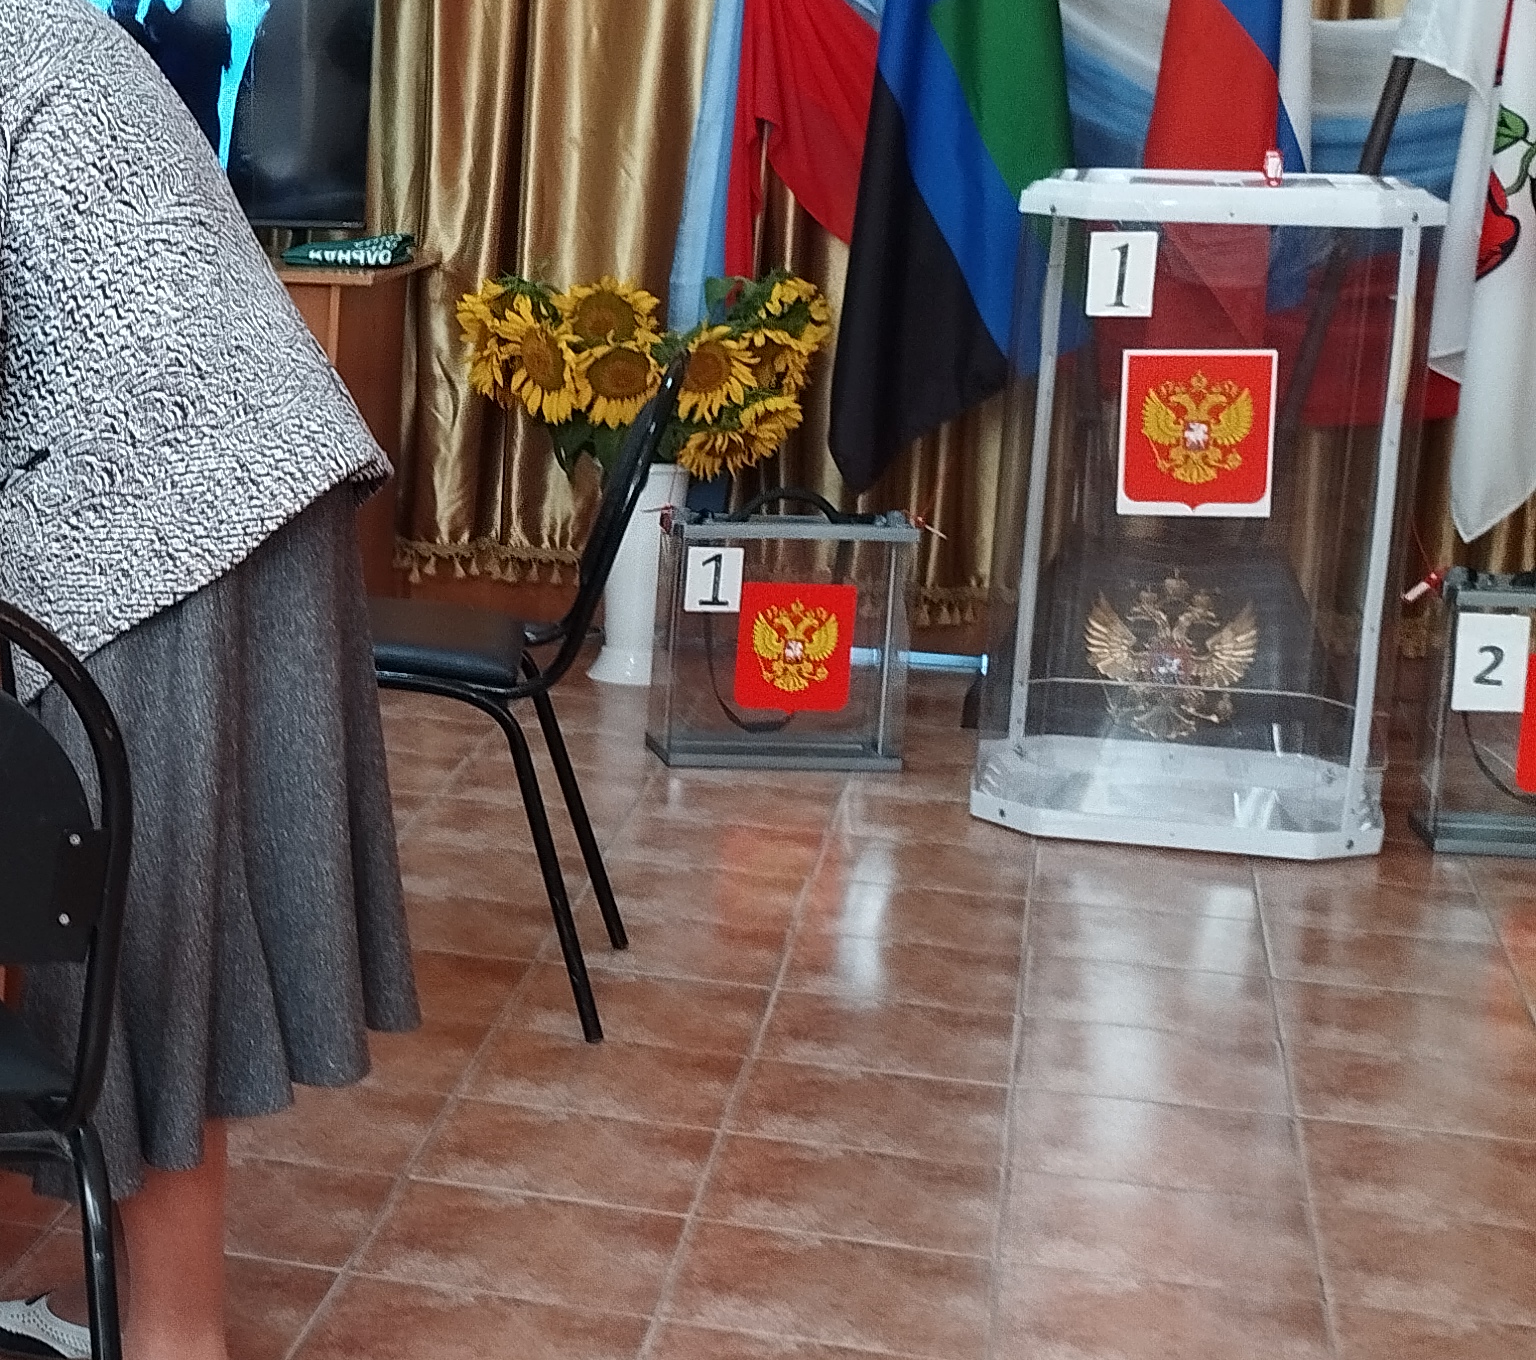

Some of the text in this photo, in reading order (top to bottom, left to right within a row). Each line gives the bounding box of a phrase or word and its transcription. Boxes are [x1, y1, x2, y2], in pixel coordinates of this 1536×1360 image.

[1110, 242, 1130, 308] 1
[697, 552, 730, 607] 1
[1472, 645, 1504, 687] 2
